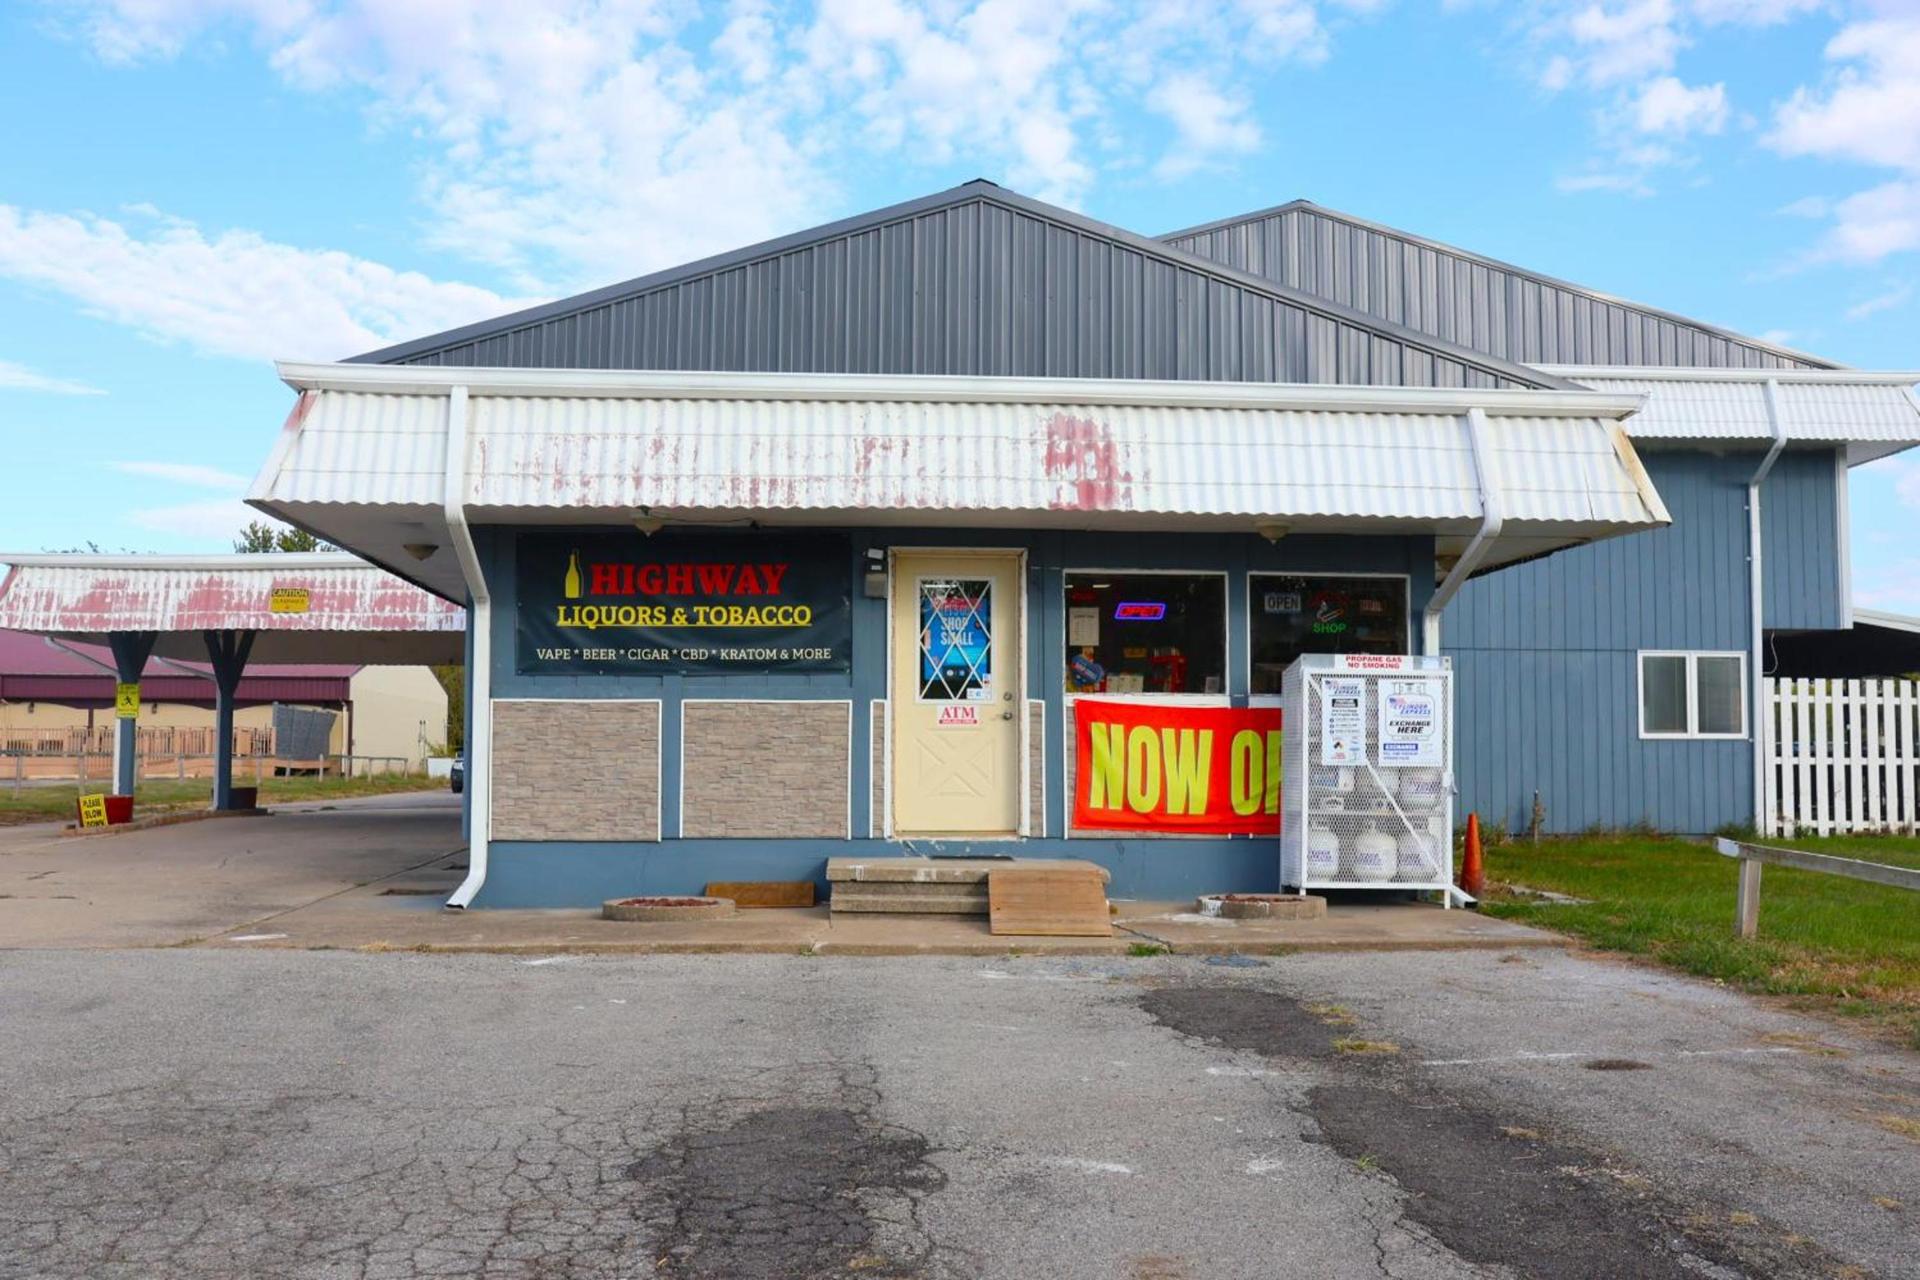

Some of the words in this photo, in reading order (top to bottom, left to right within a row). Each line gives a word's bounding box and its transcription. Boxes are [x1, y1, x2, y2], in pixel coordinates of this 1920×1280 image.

[591, 564, 788, 595] HIGHWAY
[271, 588, 310, 597] CAUTION
[1268, 595, 1299, 609] OPEN
[557, 605, 666, 629] LIQUORS
[671, 606, 687, 625] &
[694, 605, 812, 625] TOBACCO
[1313, 622, 1346, 633] SHOP
[536, 648, 571, 661] VAPE
[583, 648, 616, 661] BEER
[628, 648, 670, 661] CIGAR
[681, 648, 709, 661] CBD
[720, 648, 777, 661] KRATOM
[780, 649, 789, 660] &
[792, 647, 831, 660] MORE
[1345, 655, 1384, 663] PROPANE
[941, 706, 975, 719] ATM
[1397, 726, 1424, 734] HERE
[1090, 722, 1213, 815] NOW
